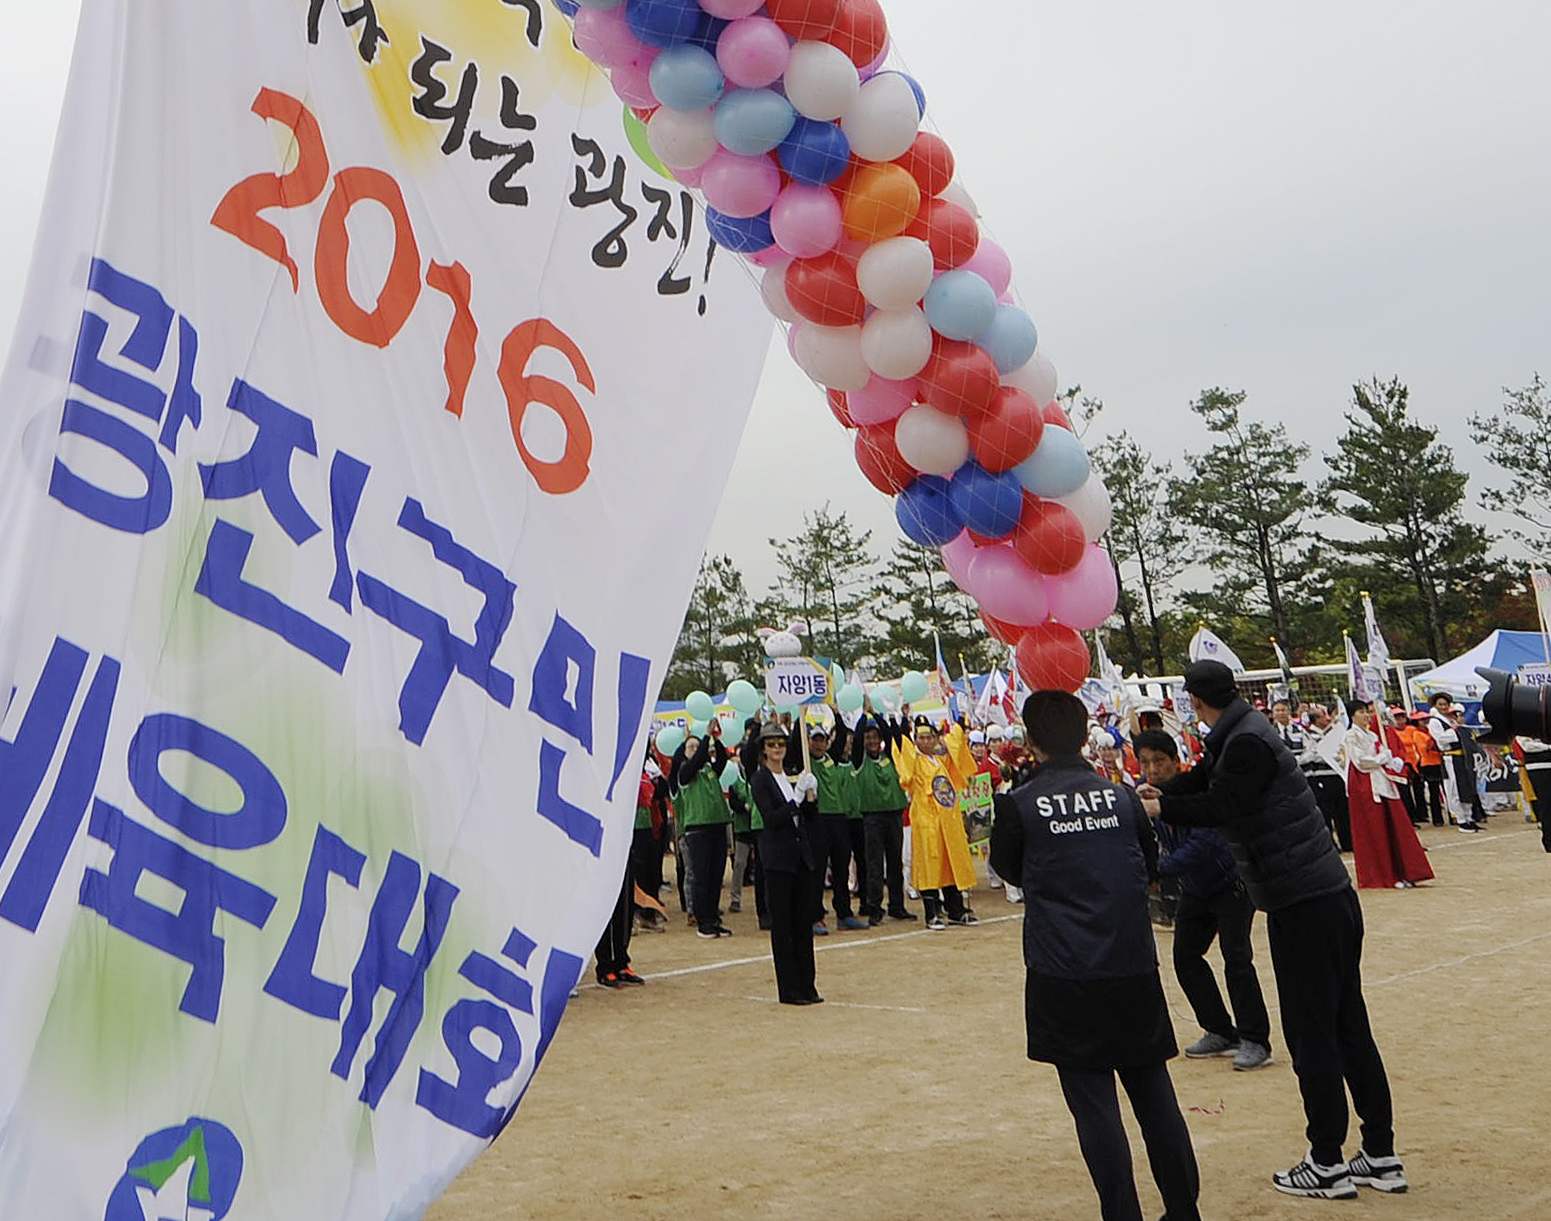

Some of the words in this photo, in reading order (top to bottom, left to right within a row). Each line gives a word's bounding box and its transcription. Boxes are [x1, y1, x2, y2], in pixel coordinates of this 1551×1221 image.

[210, 86, 595, 494] 2016
[412, 35, 536, 205] 되는
[568, 132, 717, 317] 광진!
[50, 257, 651, 858] 광진구민
[1036, 789, 1116, 817] STAFF
[1049, 818, 1083, 834] Good
[1085, 814, 1119, 830] Event
